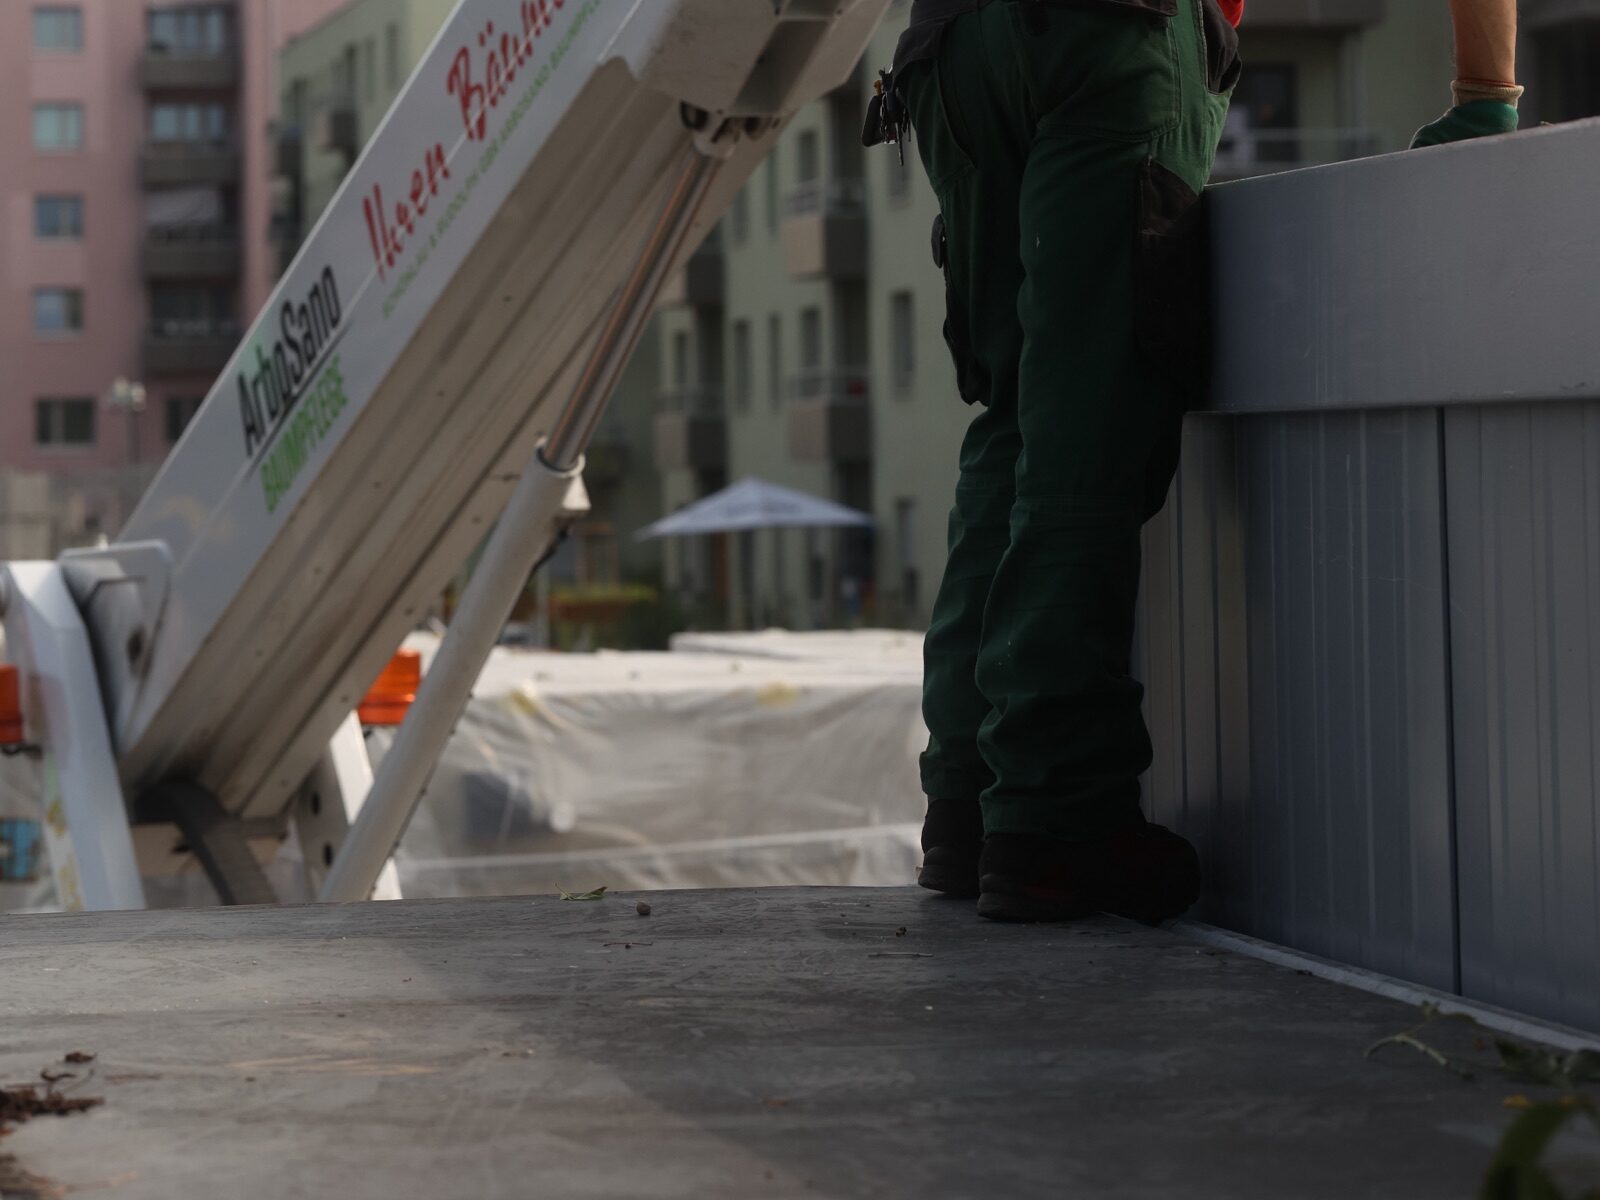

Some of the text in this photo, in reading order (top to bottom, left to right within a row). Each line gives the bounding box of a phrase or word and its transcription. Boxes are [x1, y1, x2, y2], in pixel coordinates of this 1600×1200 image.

[362, 142, 451, 284] Ihren
[237, 264, 342, 458] ArboSano
[260, 351, 348, 514] BAUMPFLEGE
